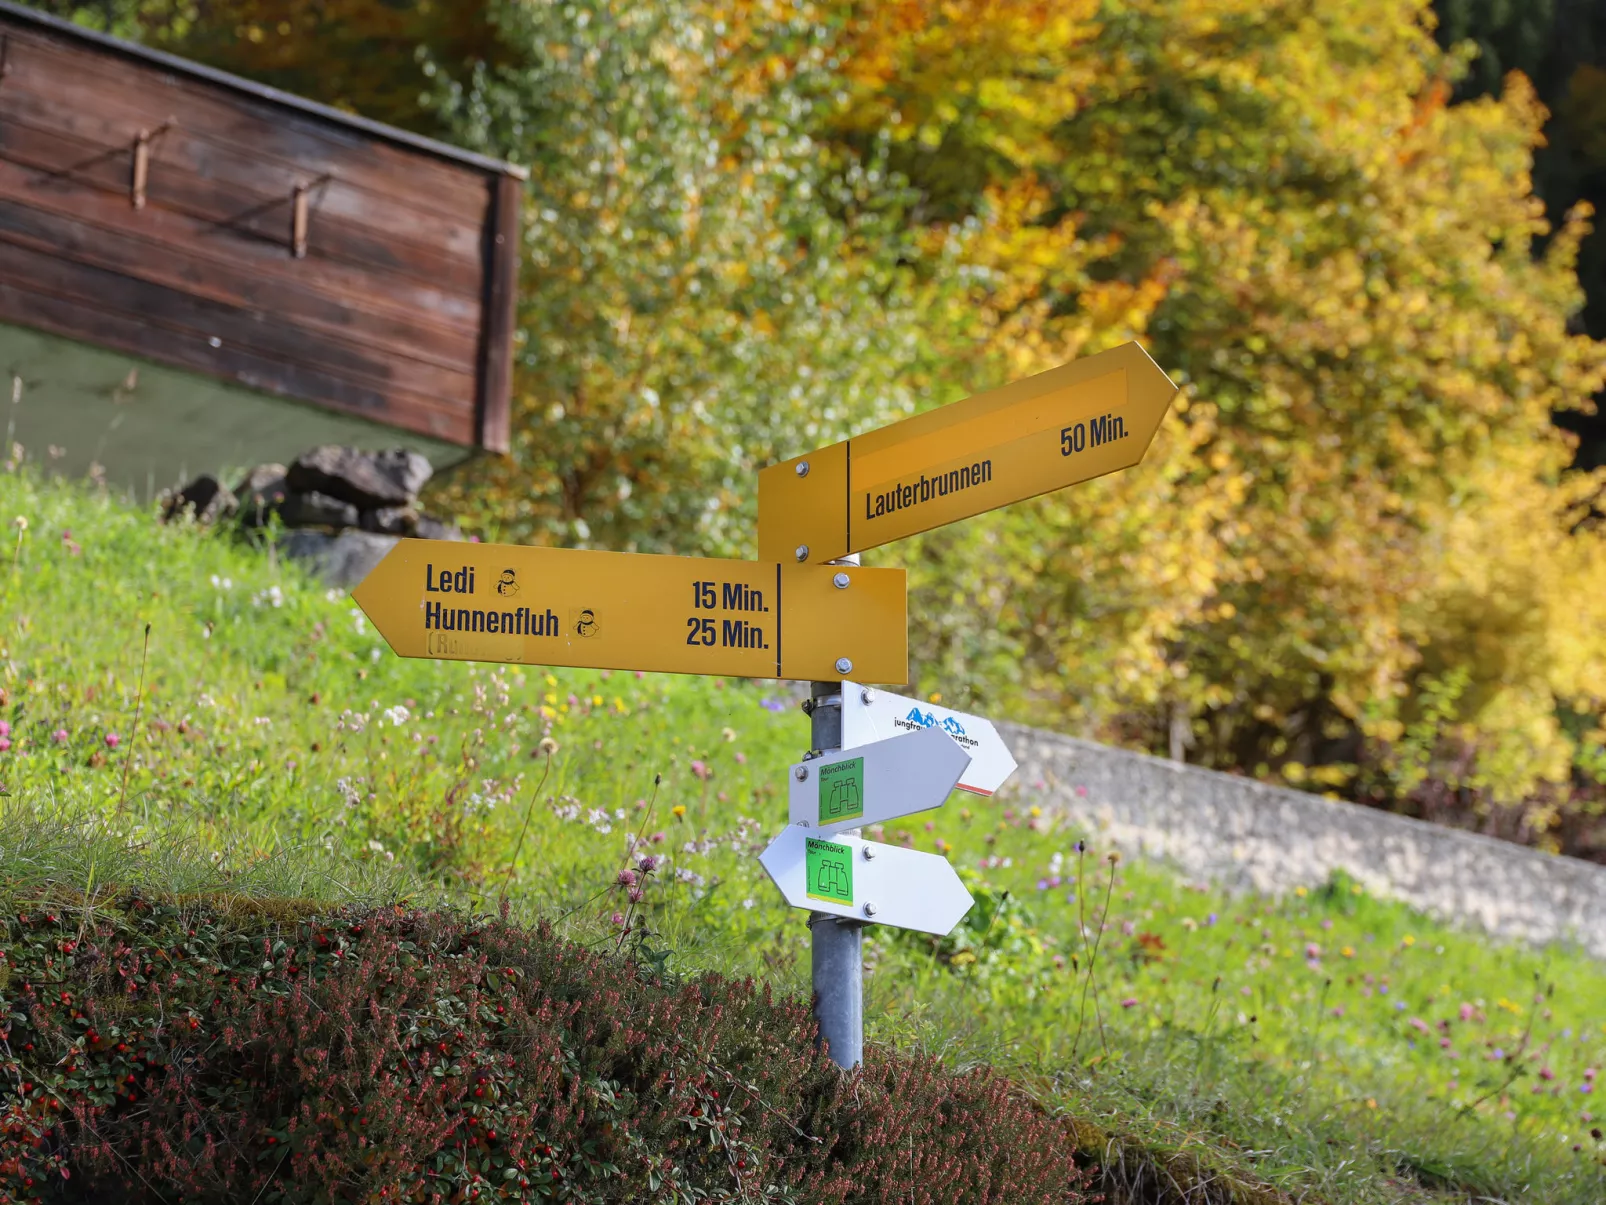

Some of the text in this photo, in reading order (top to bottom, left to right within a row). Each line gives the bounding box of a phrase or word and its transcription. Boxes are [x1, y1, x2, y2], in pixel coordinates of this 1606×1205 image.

[866, 413, 1129, 520] Lauterbrunnen 50 Min.
[426, 564, 769, 612] Ledi 15 Min.
[425, 601, 769, 649] Hunnenfluh 25 Min.
[894, 716, 925, 731] jungfra
